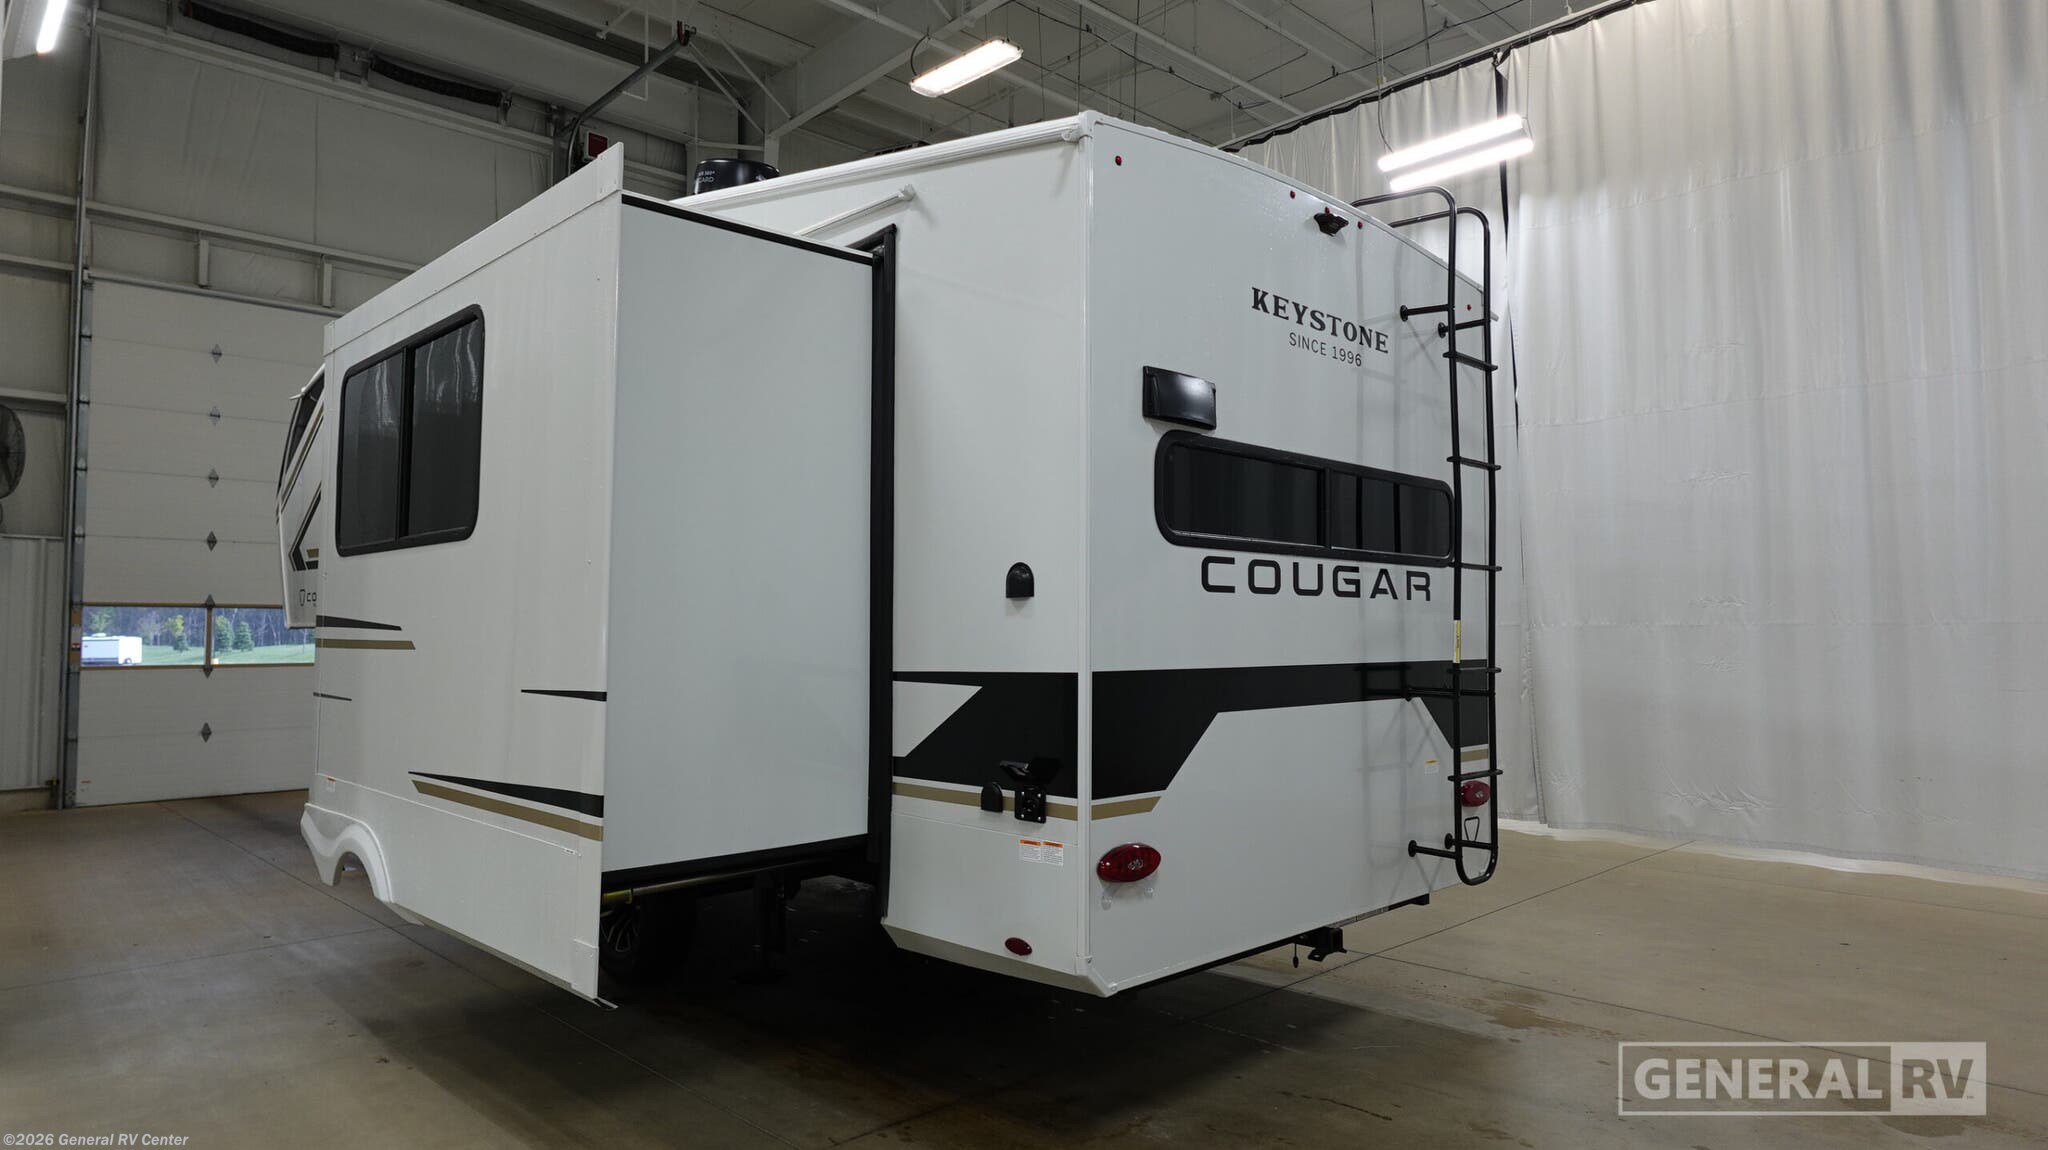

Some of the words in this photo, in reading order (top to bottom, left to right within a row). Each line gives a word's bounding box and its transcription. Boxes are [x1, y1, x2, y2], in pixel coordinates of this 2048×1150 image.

[1251, 286, 1389, 354] KEYSTONE
[1288, 332, 1327, 356] SINCE
[1331, 346, 1362, 367] 1996
[1201, 555, 1431, 602] COUGAR
